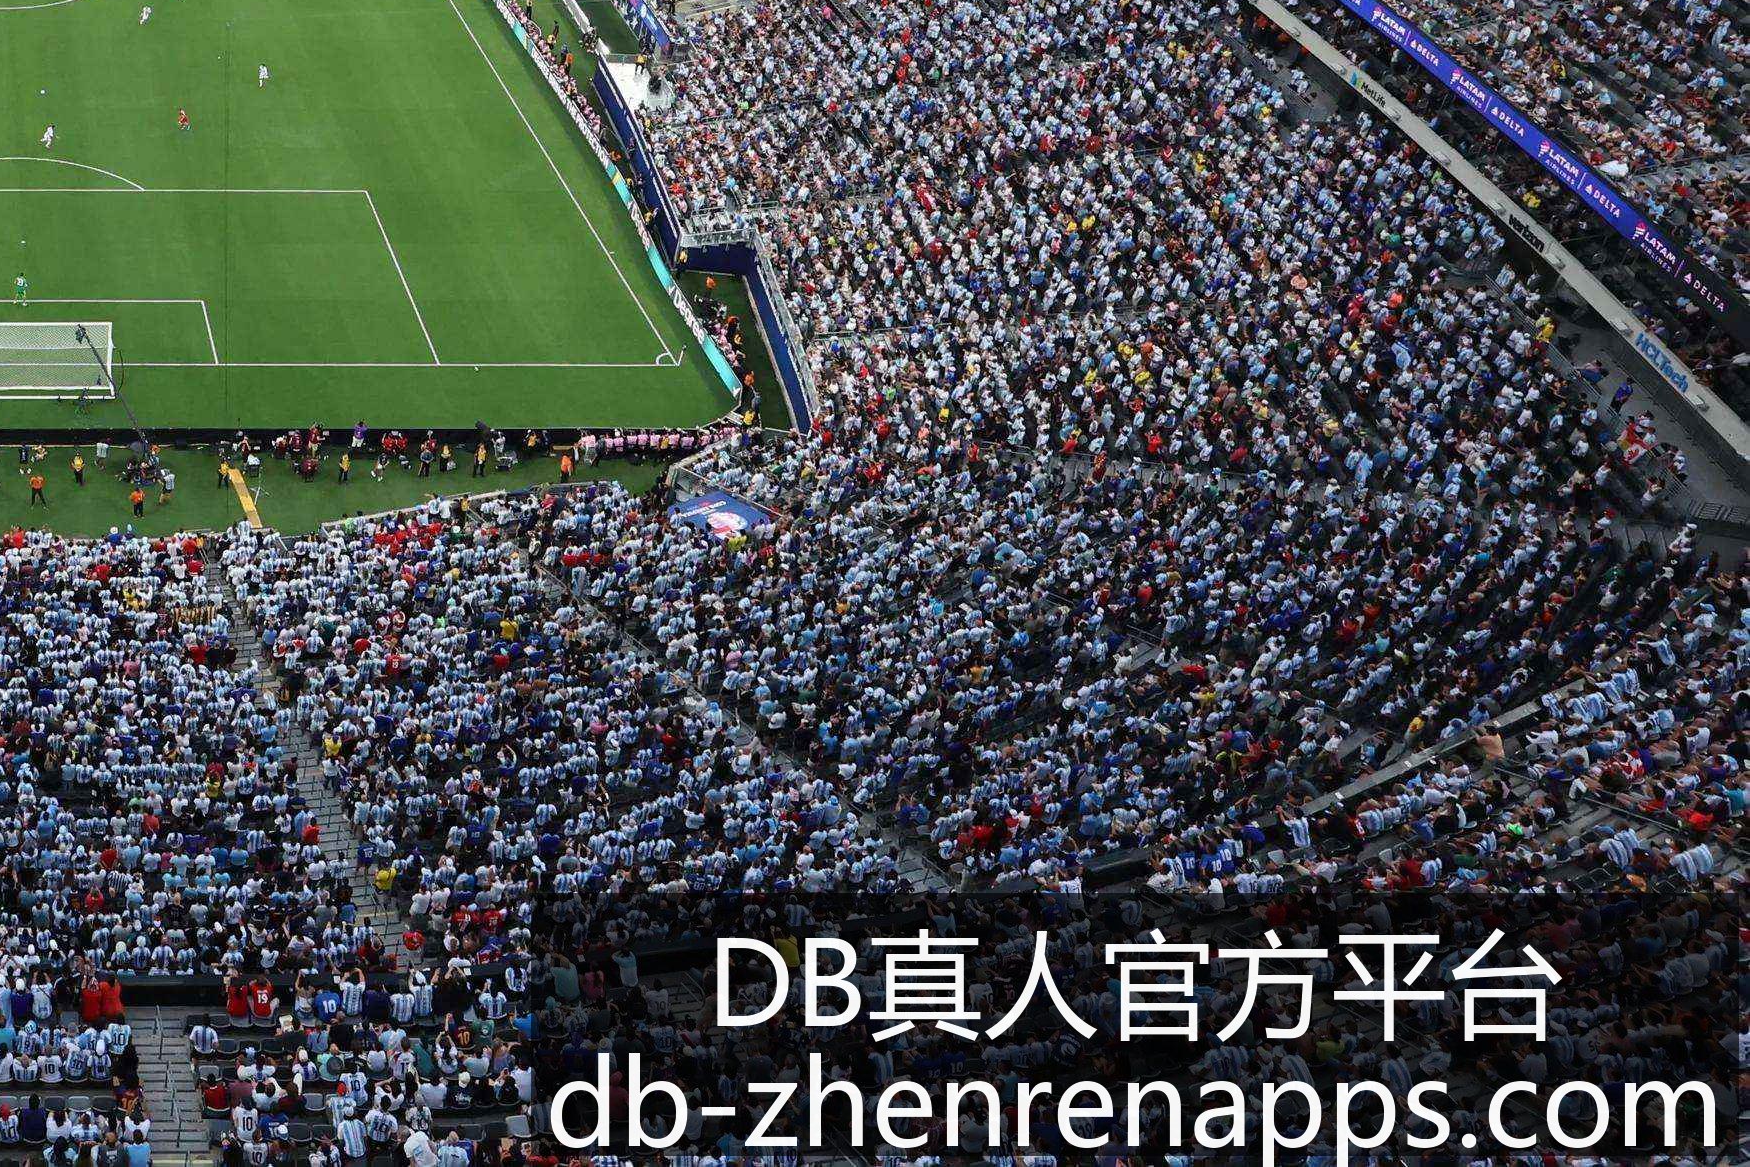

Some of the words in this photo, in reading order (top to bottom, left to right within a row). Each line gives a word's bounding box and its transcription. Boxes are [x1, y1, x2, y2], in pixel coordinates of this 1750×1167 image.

[1380, 12, 1406, 35] LATAM
[1416, 42, 1439, 66] DELTA
[1361, 82, 1387, 108] MetLife
[1456, 86, 1483, 109] AIRLINES
[1458, 74, 1486, 102] LATAM
[1498, 111, 1524, 137] DELTA
[1545, 158, 1576, 185] AIRLINES
[1549, 148, 1580, 175] LATAM
[1593, 189, 1621, 218] DELTA
[1644, 231, 1676, 265] LATAM
[1693, 280, 1725, 312] DELTA
[673, 290, 706, 345] Degree
[1635, 331, 1689, 393] HCLTech
[1211, 860, 1222, 871] 10
[1221, 848, 1232, 860] 10
[323, 999, 336, 1014] 10
[113, 1032, 124, 1045] 10
[459, 1031, 469, 1045] 10
[46, 1063, 55, 1074] 10
[351, 1079, 360, 1091] 10
[242, 1116, 253, 1131] 10
[251, 1150, 262, 1164] 10
